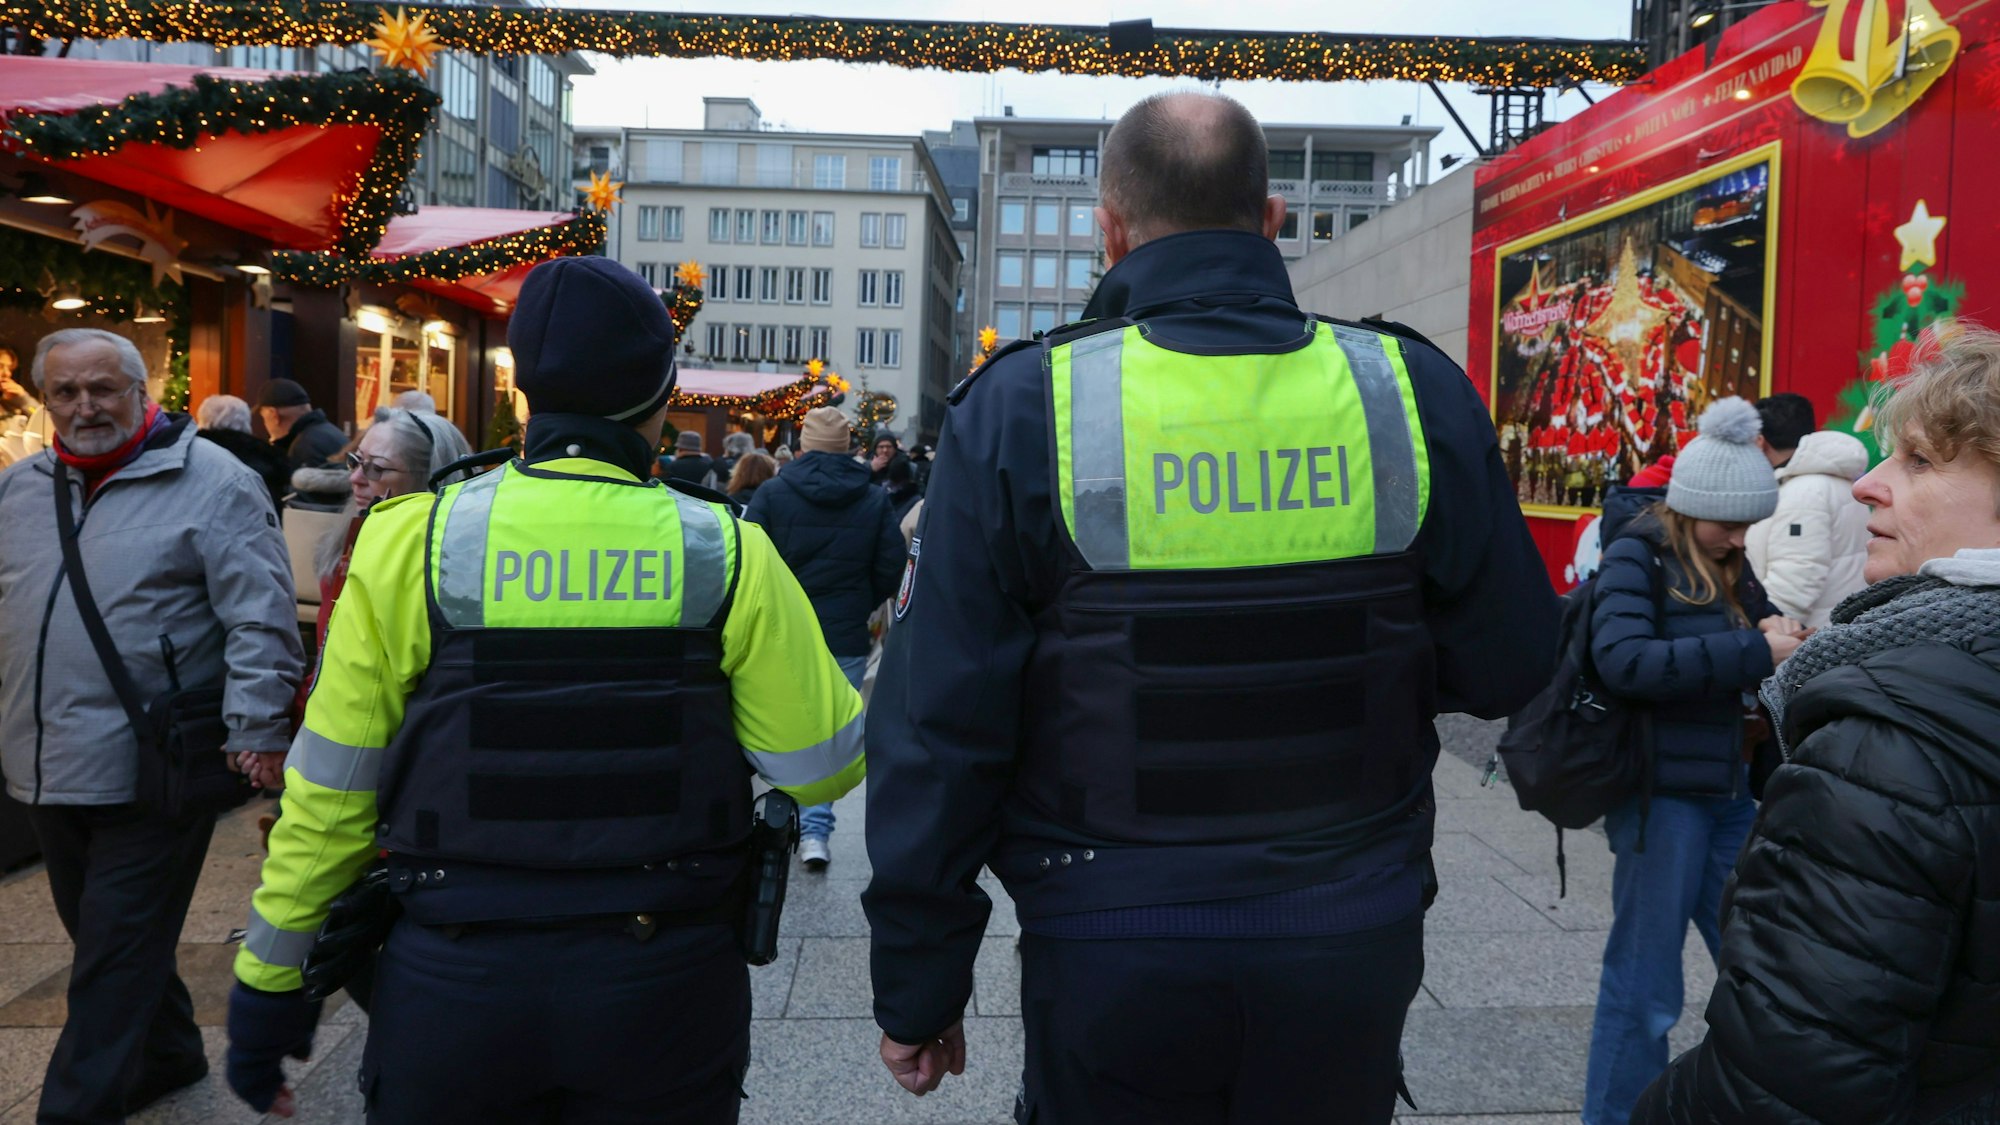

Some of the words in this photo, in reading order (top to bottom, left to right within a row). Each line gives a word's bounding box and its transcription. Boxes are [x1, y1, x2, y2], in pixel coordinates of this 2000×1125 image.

[1713, 71, 1747, 104] FELIZ
[1749, 45, 1803, 86] NAVIDAD
[1153, 445, 1350, 514] POLIZEI
[494, 549, 672, 601] POLIZEI
